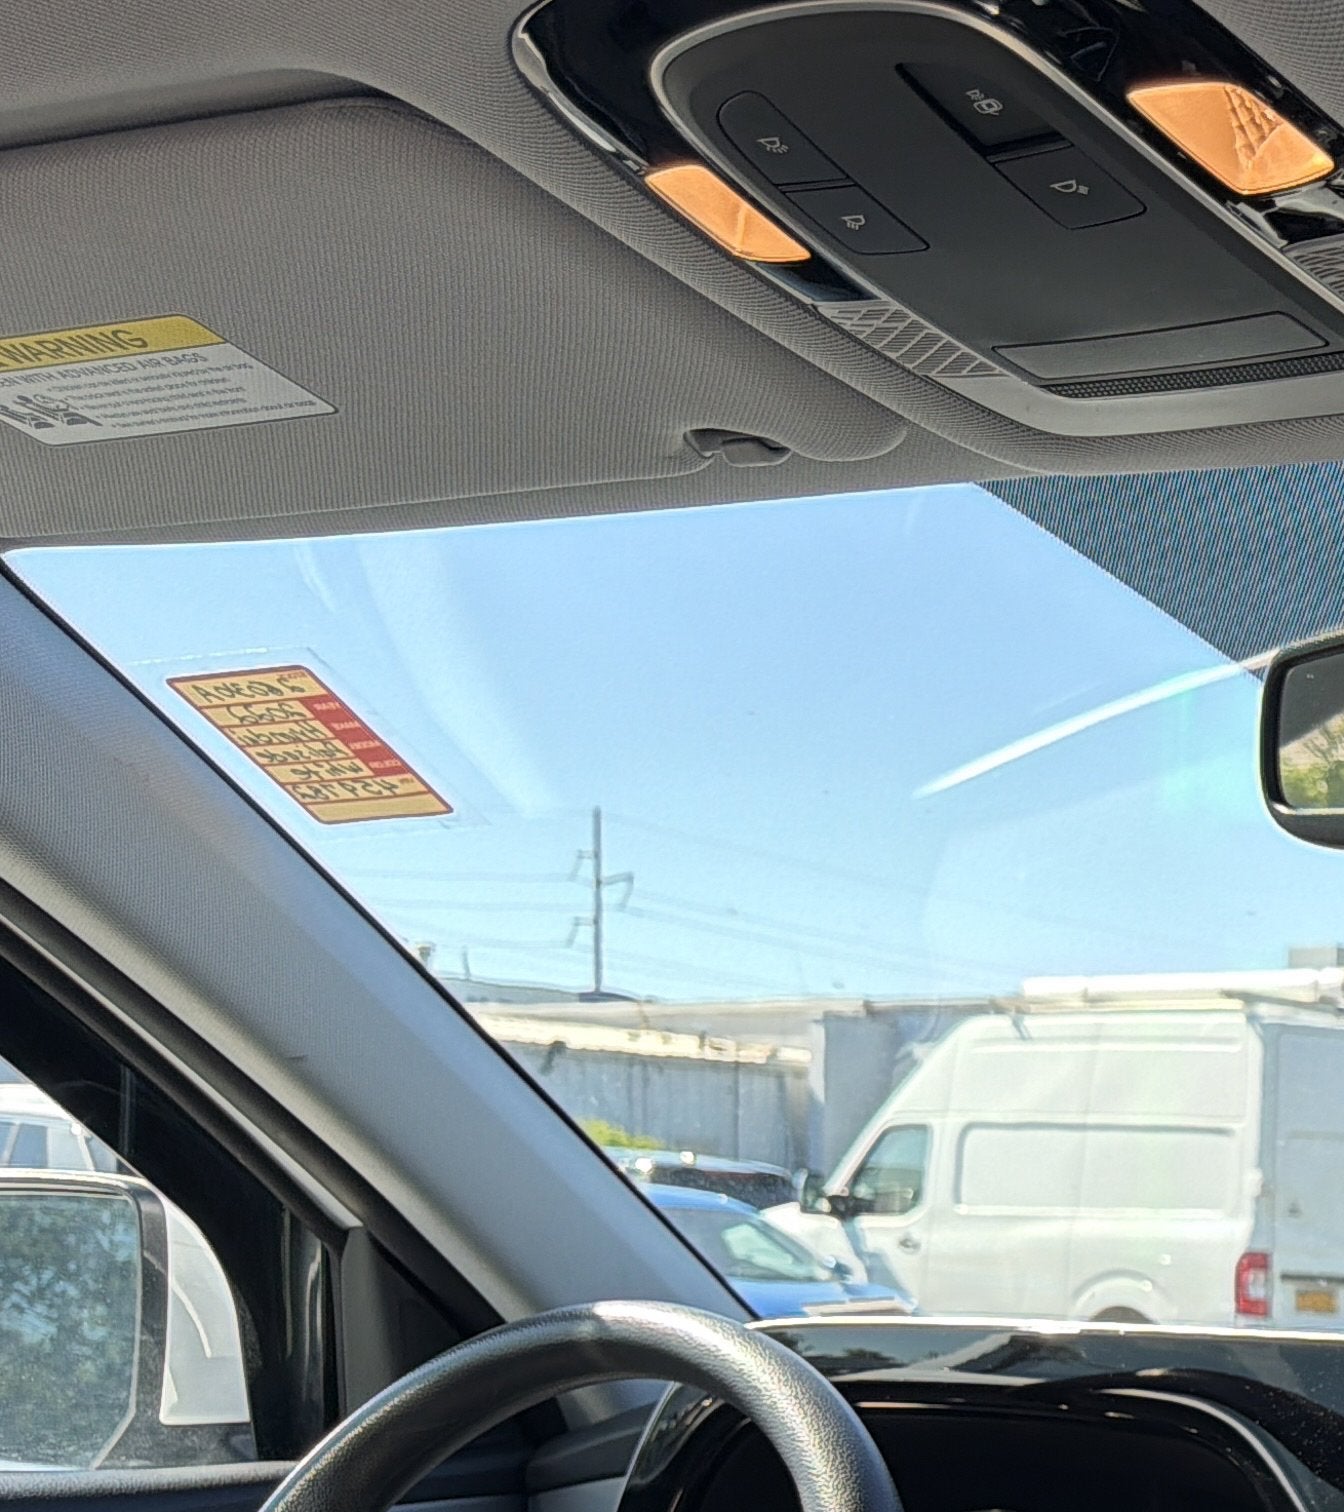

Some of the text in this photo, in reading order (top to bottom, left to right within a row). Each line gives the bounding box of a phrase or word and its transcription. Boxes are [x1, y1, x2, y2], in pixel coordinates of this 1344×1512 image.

[0, 330, 148, 363] WARNING
[57, 361, 138, 380] ADVANCED
[138, 356, 166, 371] AIR
[162, 352, 208, 366] BAGS
